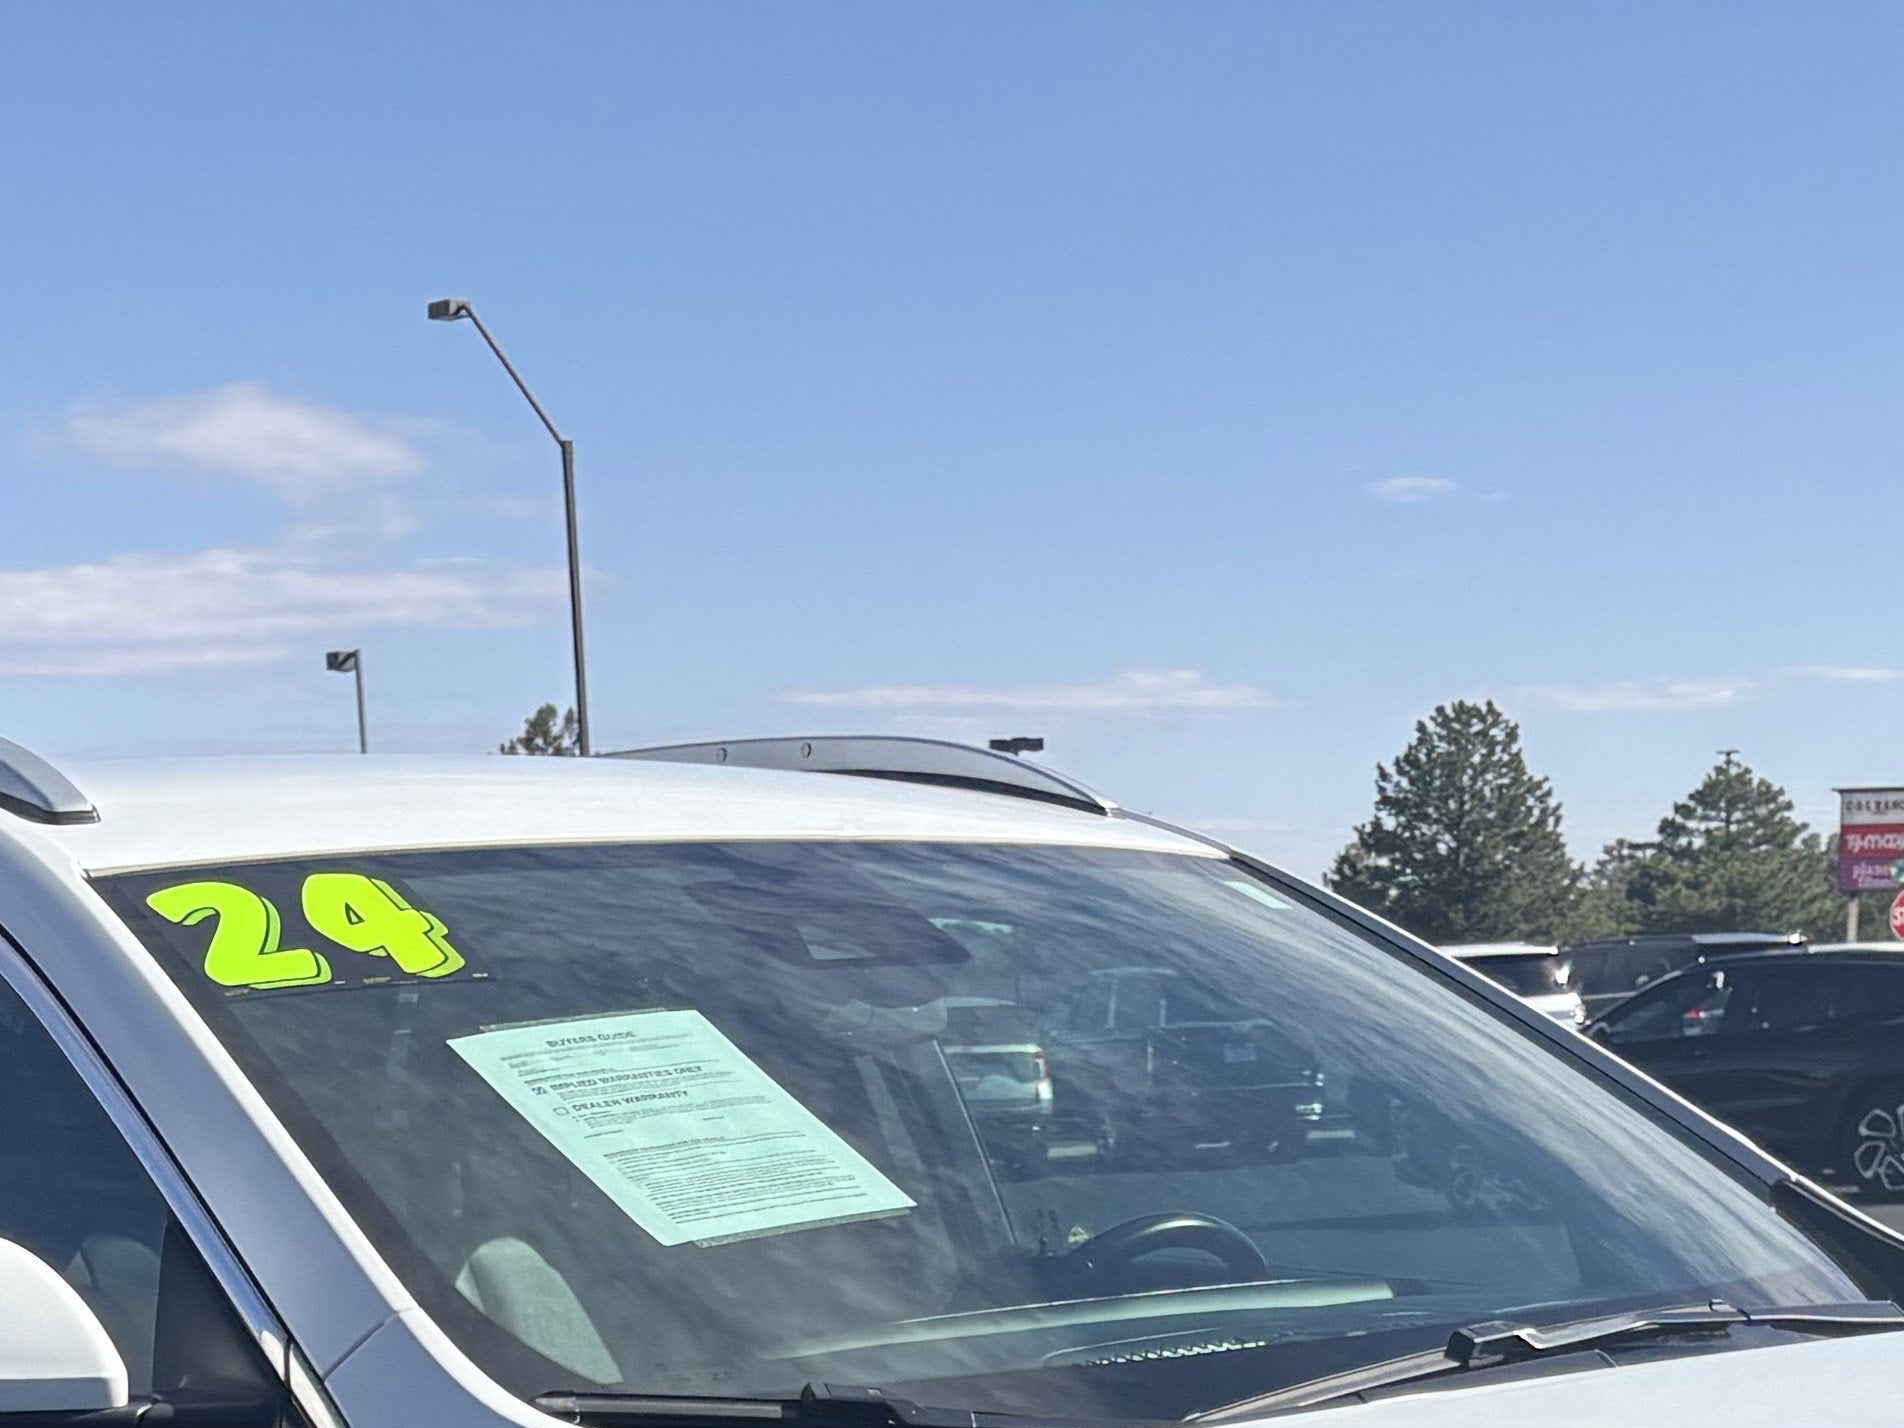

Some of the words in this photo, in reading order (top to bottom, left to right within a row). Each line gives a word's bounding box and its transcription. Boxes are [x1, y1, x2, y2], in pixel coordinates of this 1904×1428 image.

[146, 873, 466, 990] 24
[546, 1035, 596, 1048] BUYERS
[597, 1030, 638, 1042] GUIDE
[549, 1078, 597, 1092] IMPLIED
[598, 1068, 673, 1085] WARRANTIES
[674, 1064, 703, 1077] ONLY
[571, 1097, 622, 1112] DEALER
[624, 1090, 689, 1106] WARRANTY
